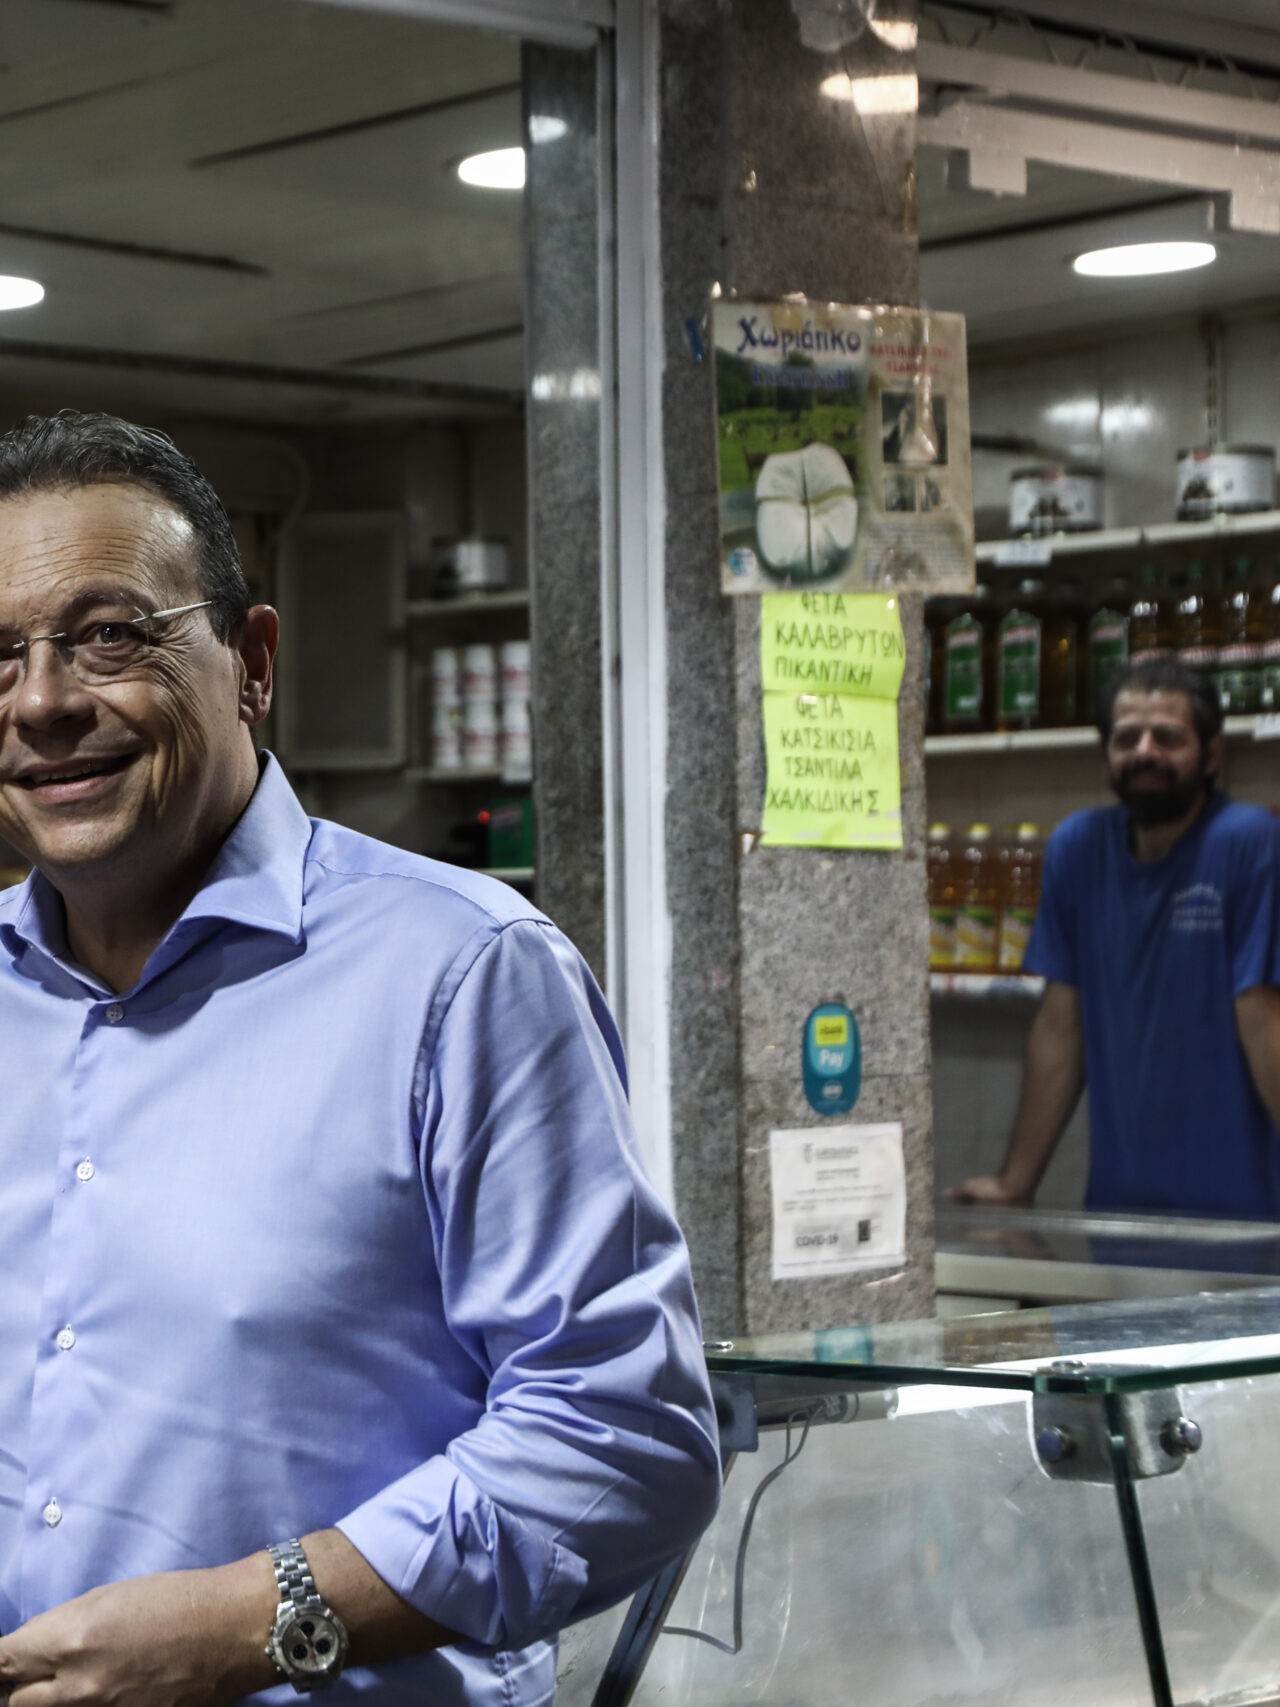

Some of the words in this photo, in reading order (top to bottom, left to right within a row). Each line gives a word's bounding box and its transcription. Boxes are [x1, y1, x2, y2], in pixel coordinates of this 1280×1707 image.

[775, 619, 904, 659] ΚΑΛΑΒΡΥΤΩΝ
[774, 656, 873, 686] ΠΙΚΑΝΤΙΚΗ
[780, 727, 877, 753] ΚΑΤΣΙΚΙΣΙΑ
[784, 756, 863, 781] ΤΣΑΝΤΙΛΑ
[767, 786, 880, 814] ΧΑΛΚΙΔΙΚΗΣ
[820, 1049, 845, 1068] Pay
